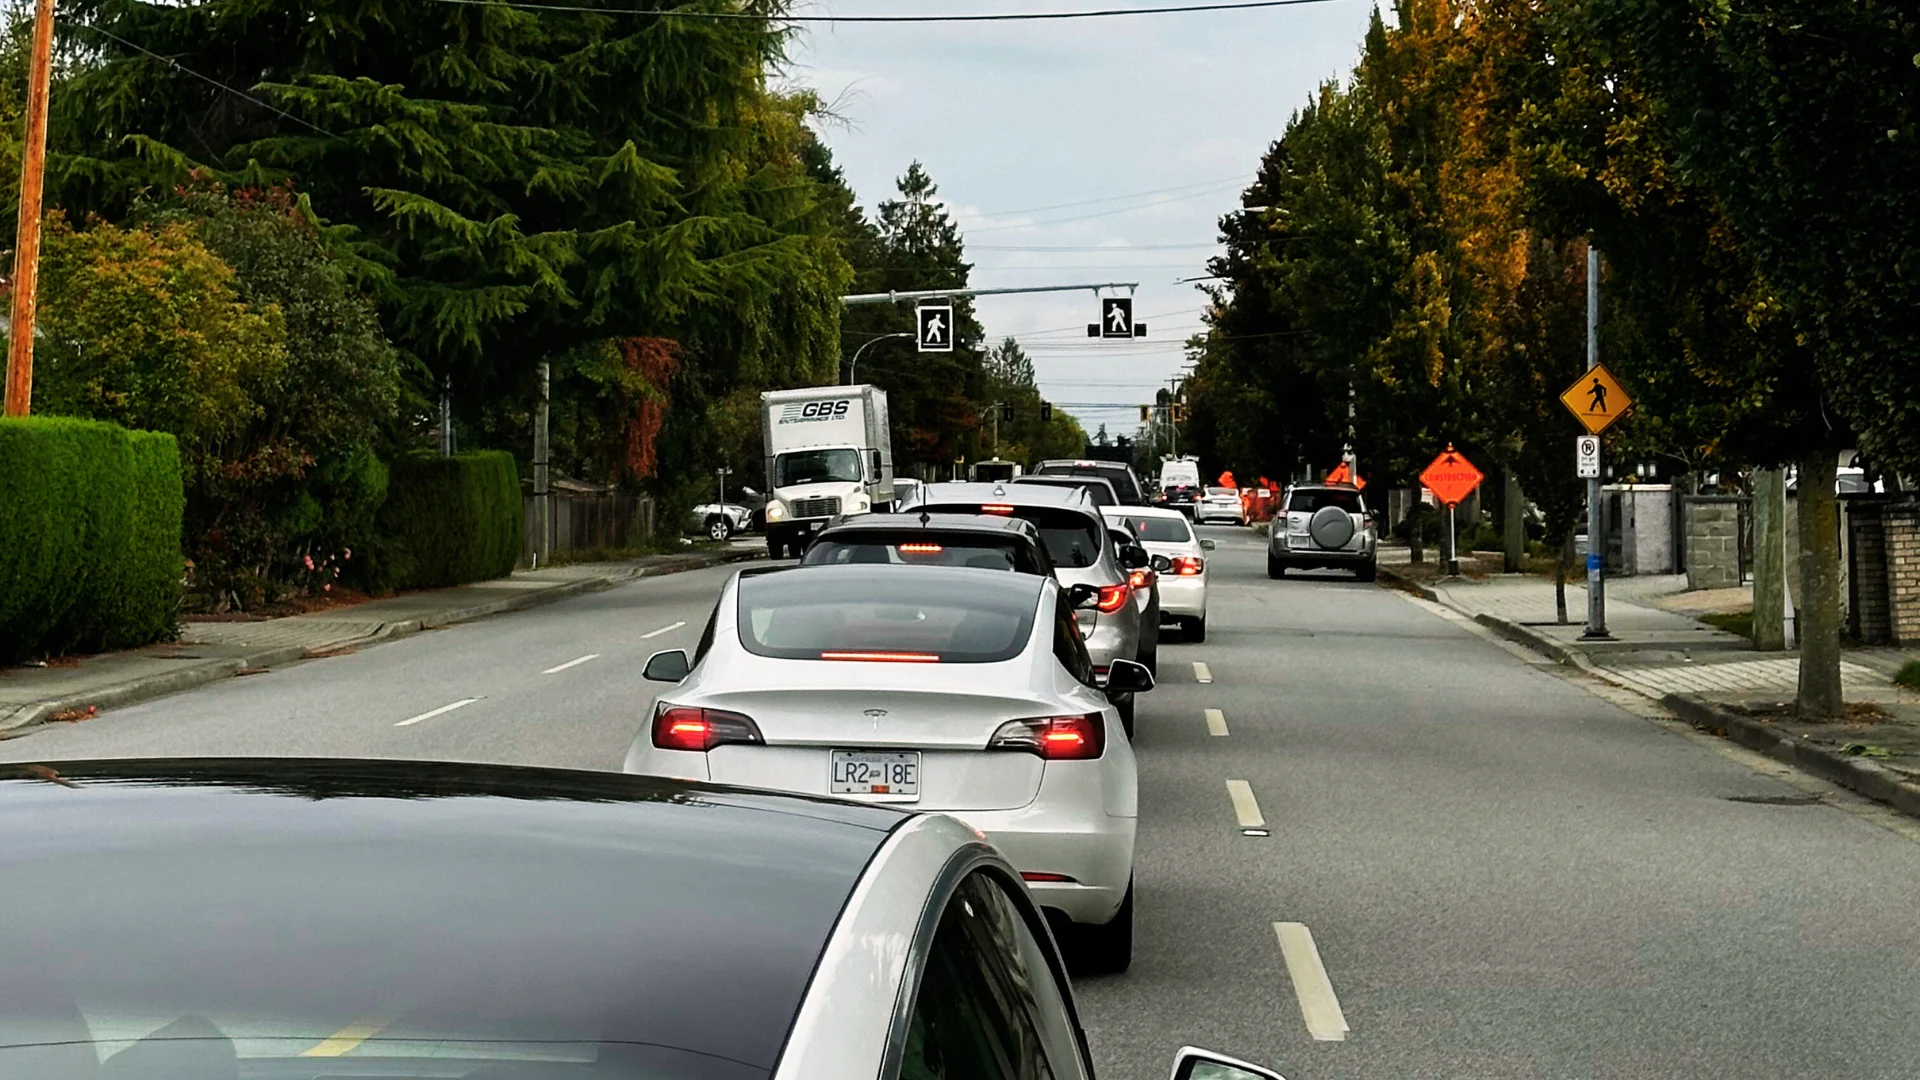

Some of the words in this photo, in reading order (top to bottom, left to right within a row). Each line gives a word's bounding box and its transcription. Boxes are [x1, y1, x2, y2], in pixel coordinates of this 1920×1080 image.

[802, 400, 850, 417] GBS
[1424, 472, 1478, 481] CONSTRUCTION
[834, 761, 869, 784] LR2
[884, 763, 916, 785] 18E
